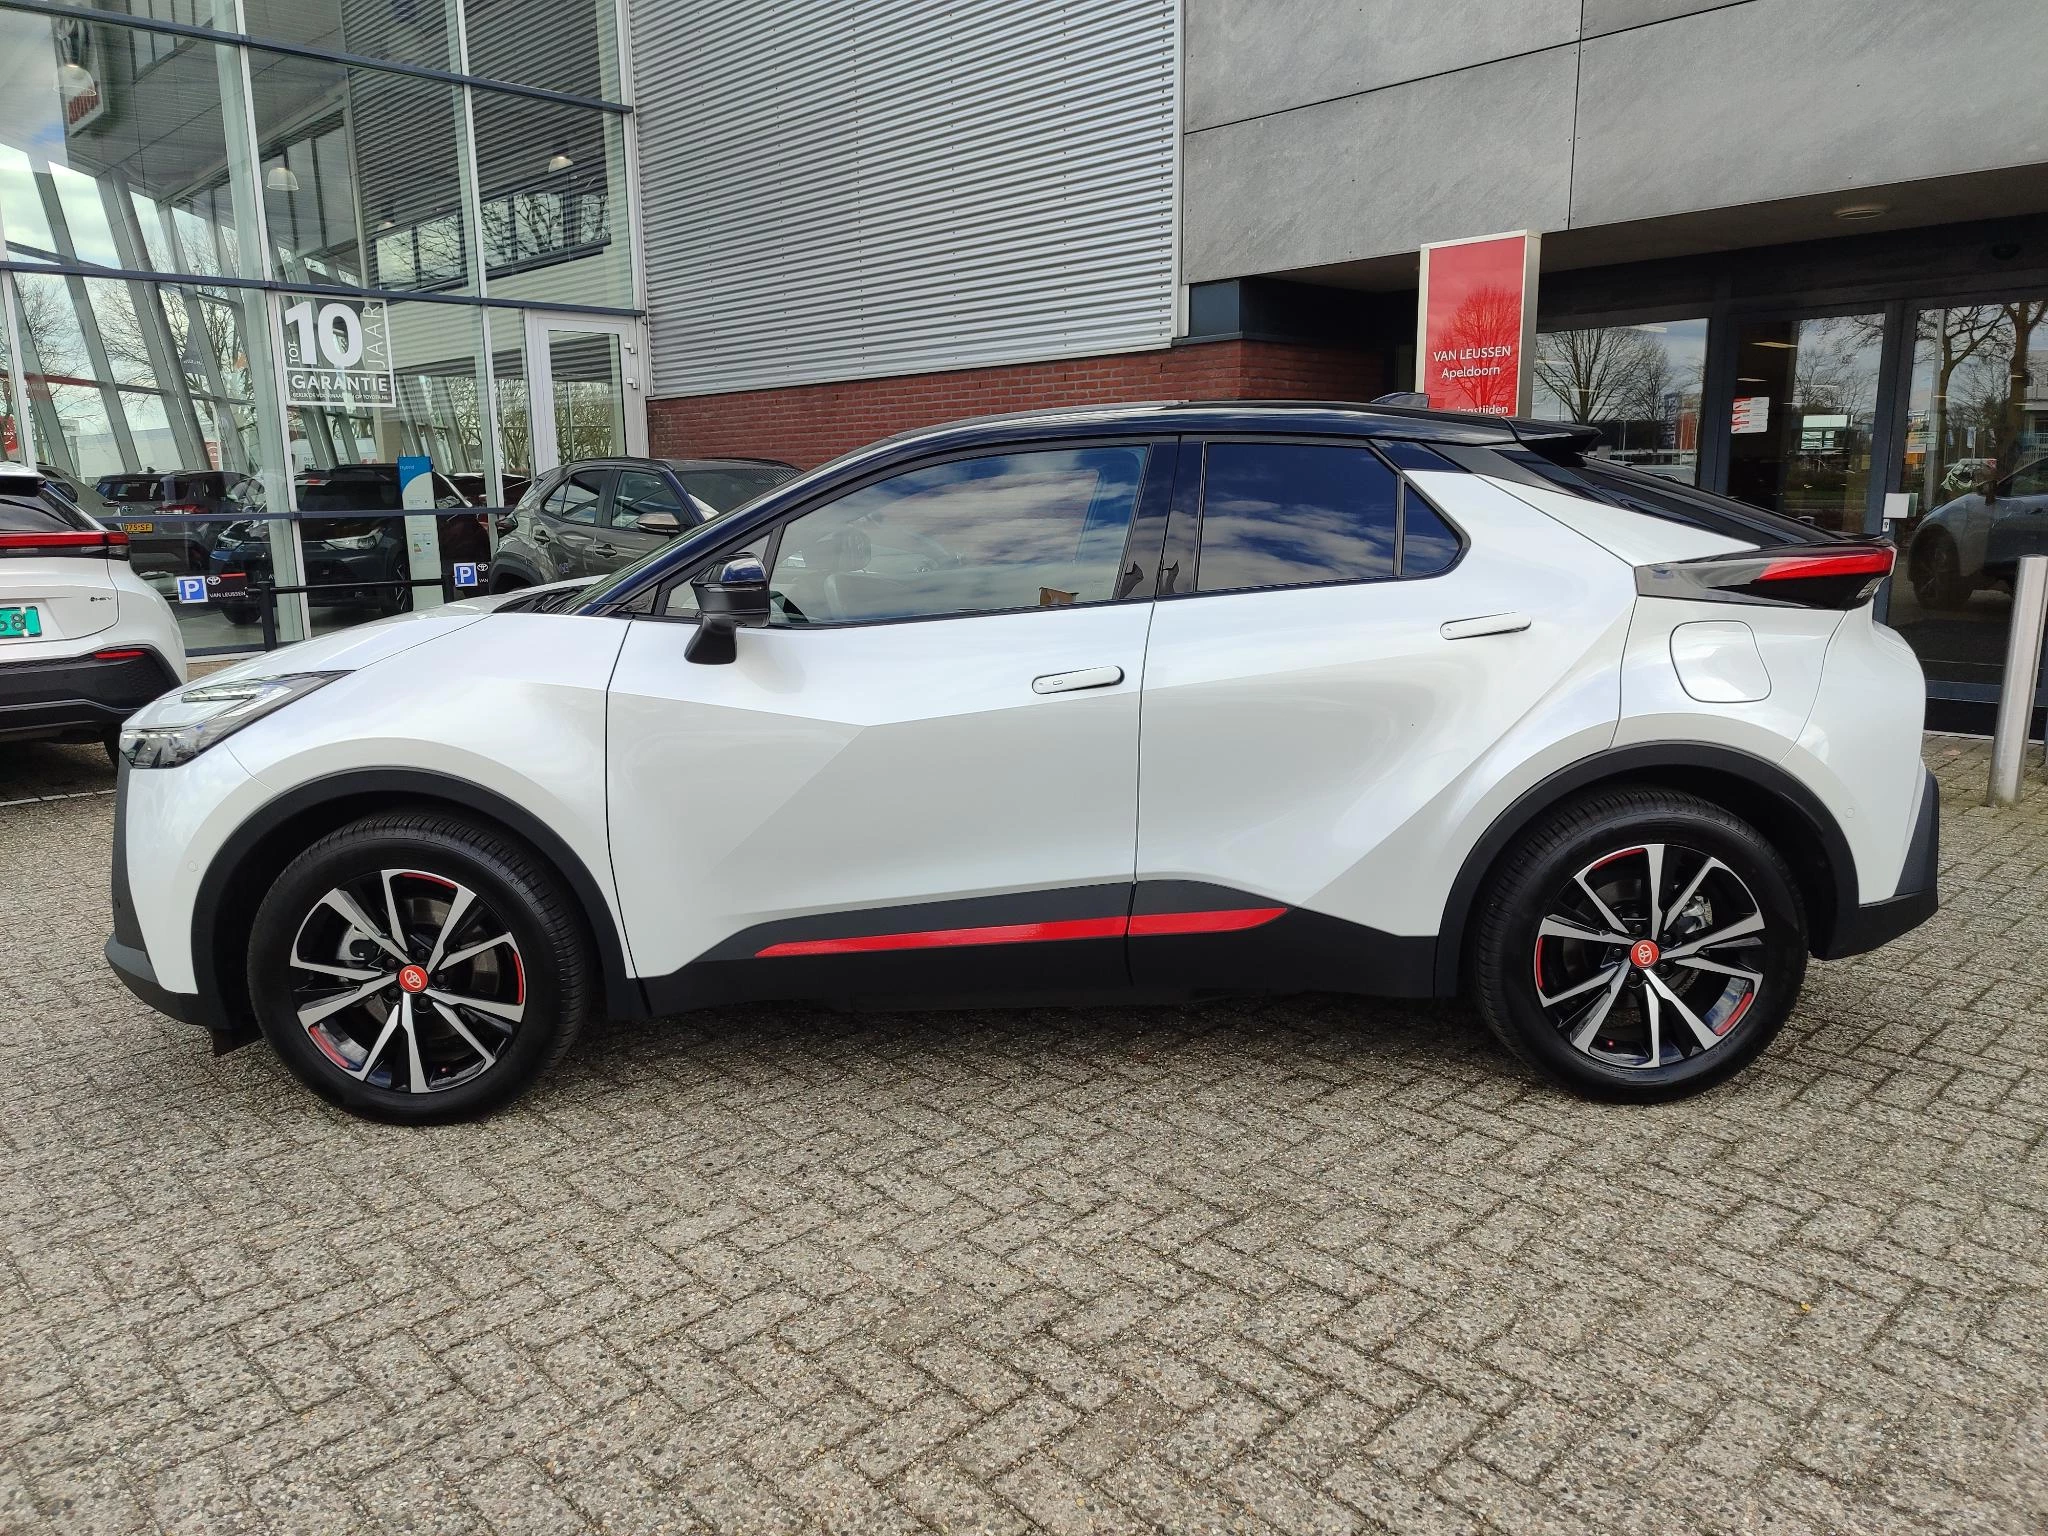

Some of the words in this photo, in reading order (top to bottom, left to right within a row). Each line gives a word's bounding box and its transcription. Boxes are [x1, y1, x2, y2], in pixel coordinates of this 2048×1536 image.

[285, 301, 363, 367] 10
[363, 306, 386, 368] JAAR
[288, 341, 300, 364] TOT
[1433, 349, 1457, 362] VAN
[1460, 345, 1511, 360] LEUSSEN
[1441, 366, 1500, 380] Apeldoorn
[291, 374, 388, 392] GARANTIE
[460, 567, 471, 583] P
[184, 580, 199, 599] P
